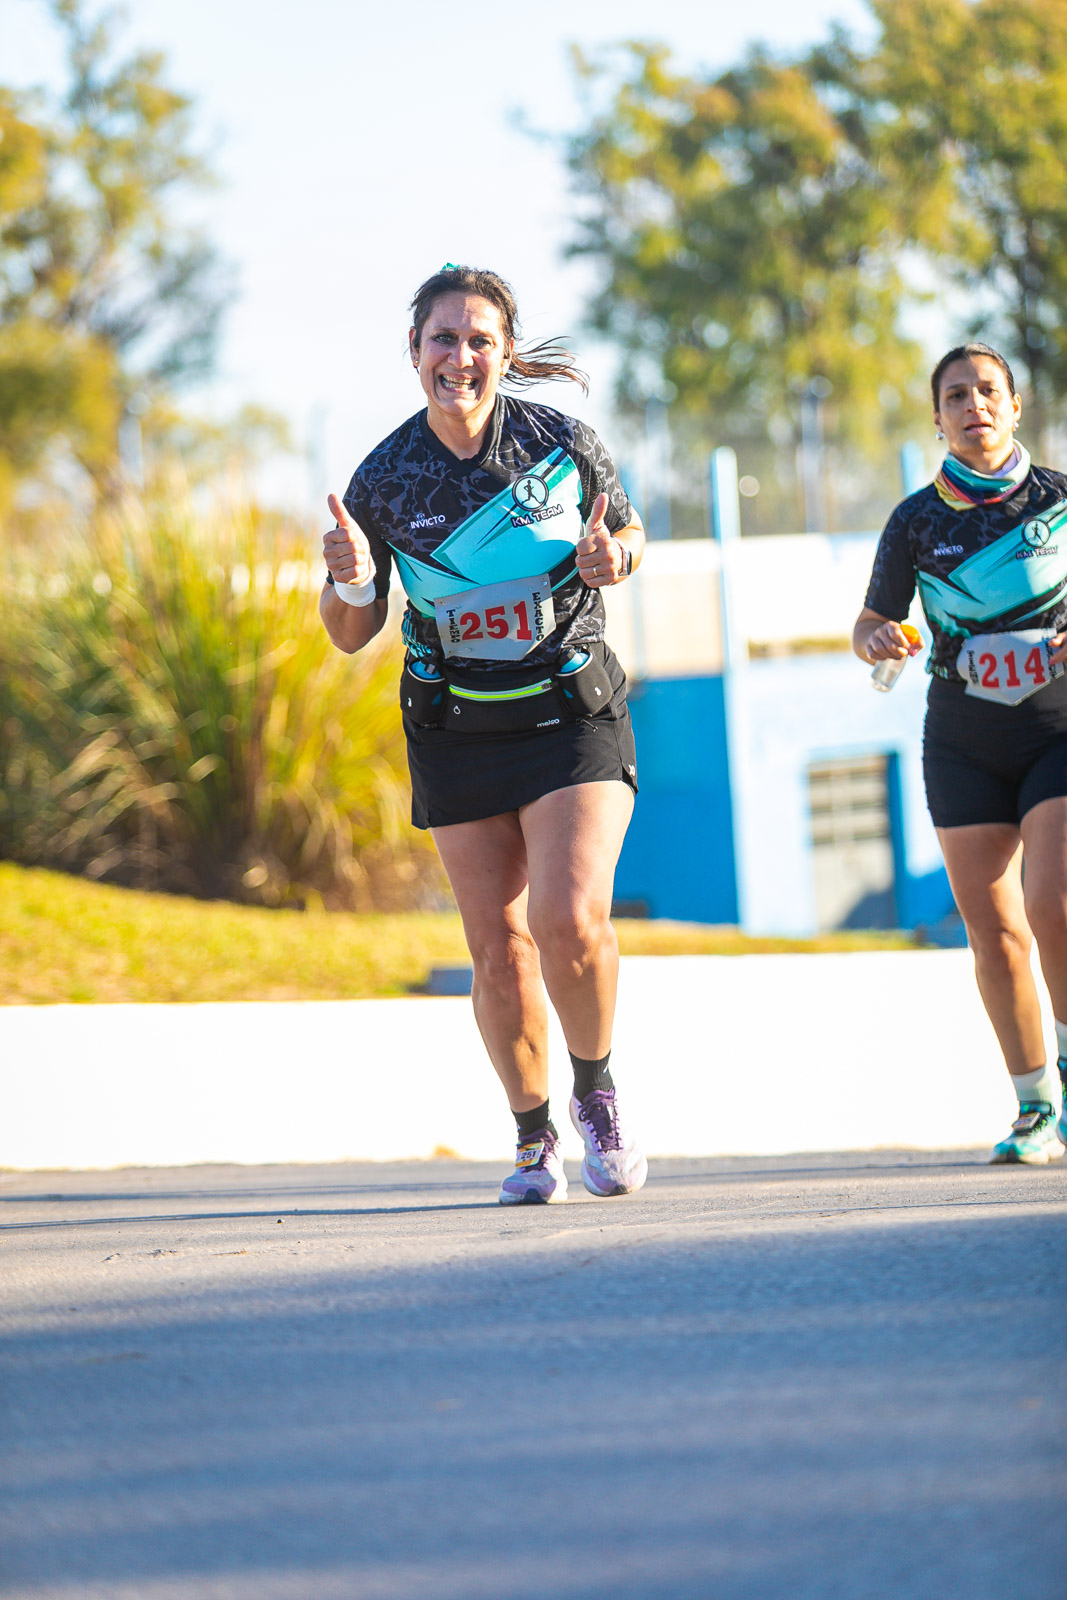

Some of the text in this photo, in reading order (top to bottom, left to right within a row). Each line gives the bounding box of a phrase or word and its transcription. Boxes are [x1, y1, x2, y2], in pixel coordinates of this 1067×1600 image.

[410, 514, 446, 529] INVICTO
[532, 504, 564, 522] TEAM
[460, 600, 532, 641] 251
[532, 592, 544, 642] EXACTO
[979, 647, 1046, 688] 214
[520, 1150, 536, 1161] 251
